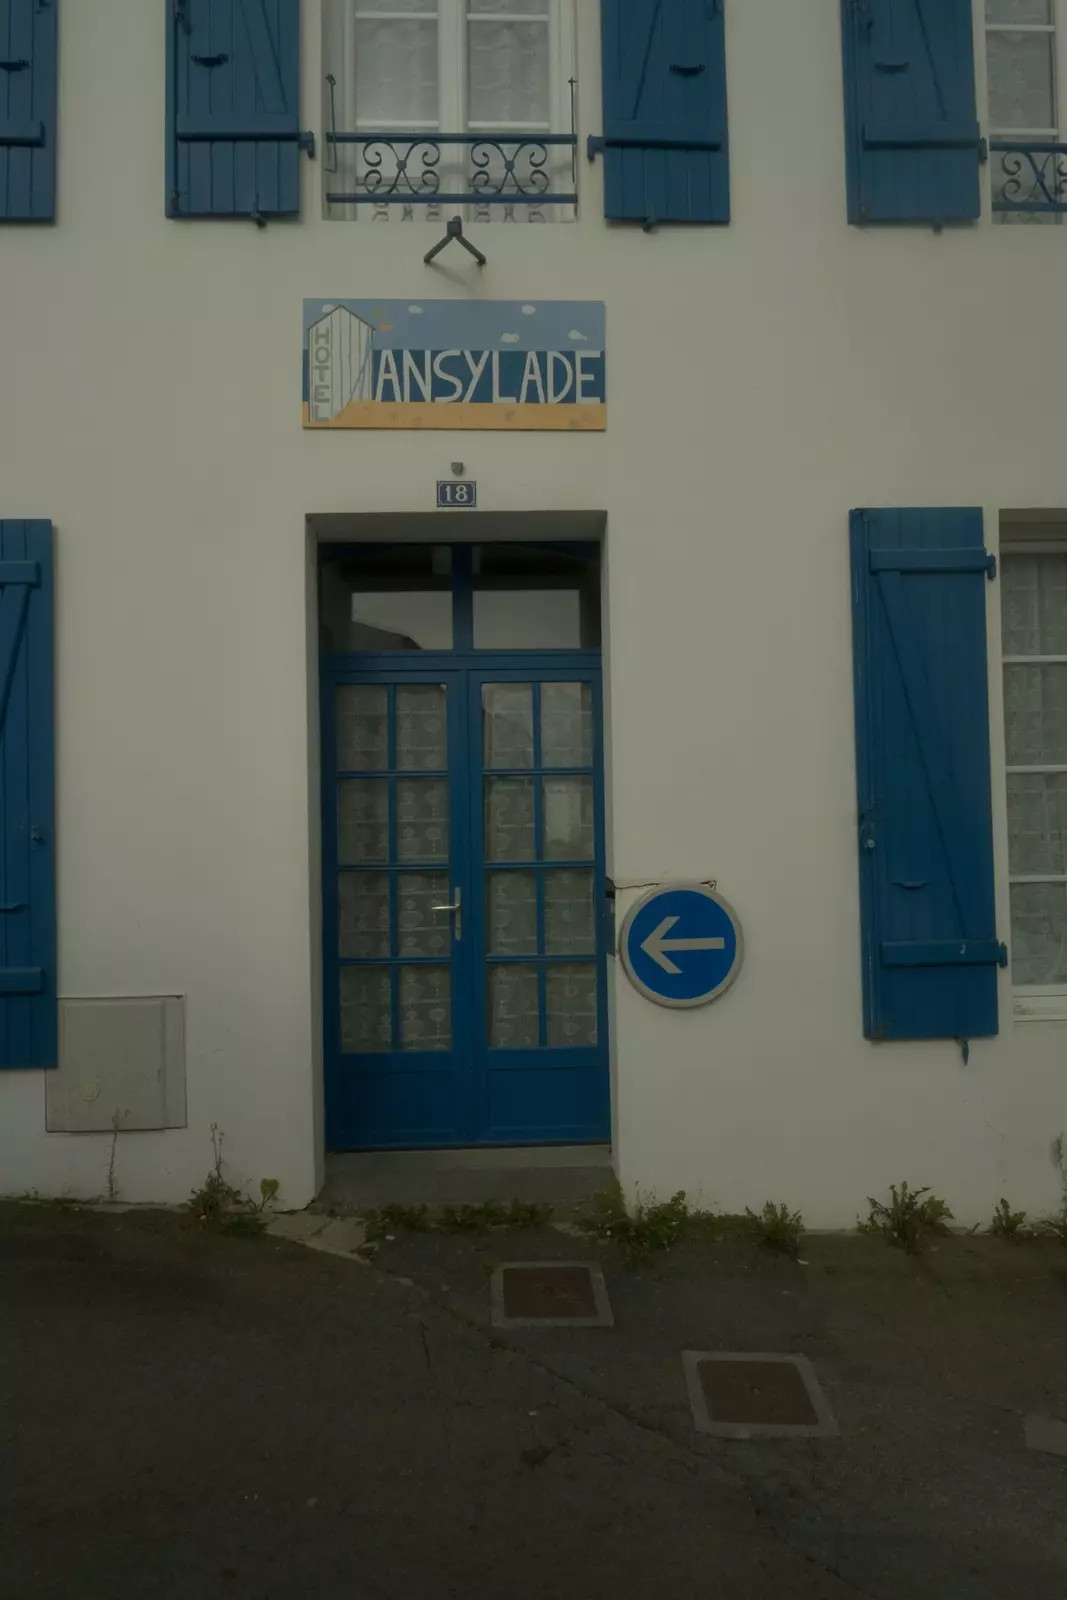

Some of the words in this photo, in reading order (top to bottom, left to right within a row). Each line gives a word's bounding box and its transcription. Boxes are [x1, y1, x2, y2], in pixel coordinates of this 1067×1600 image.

[314, 327, 331, 422] HOTEL
[375, 348, 601, 404] ANSYLADE
[444, 484, 469, 503] 18
